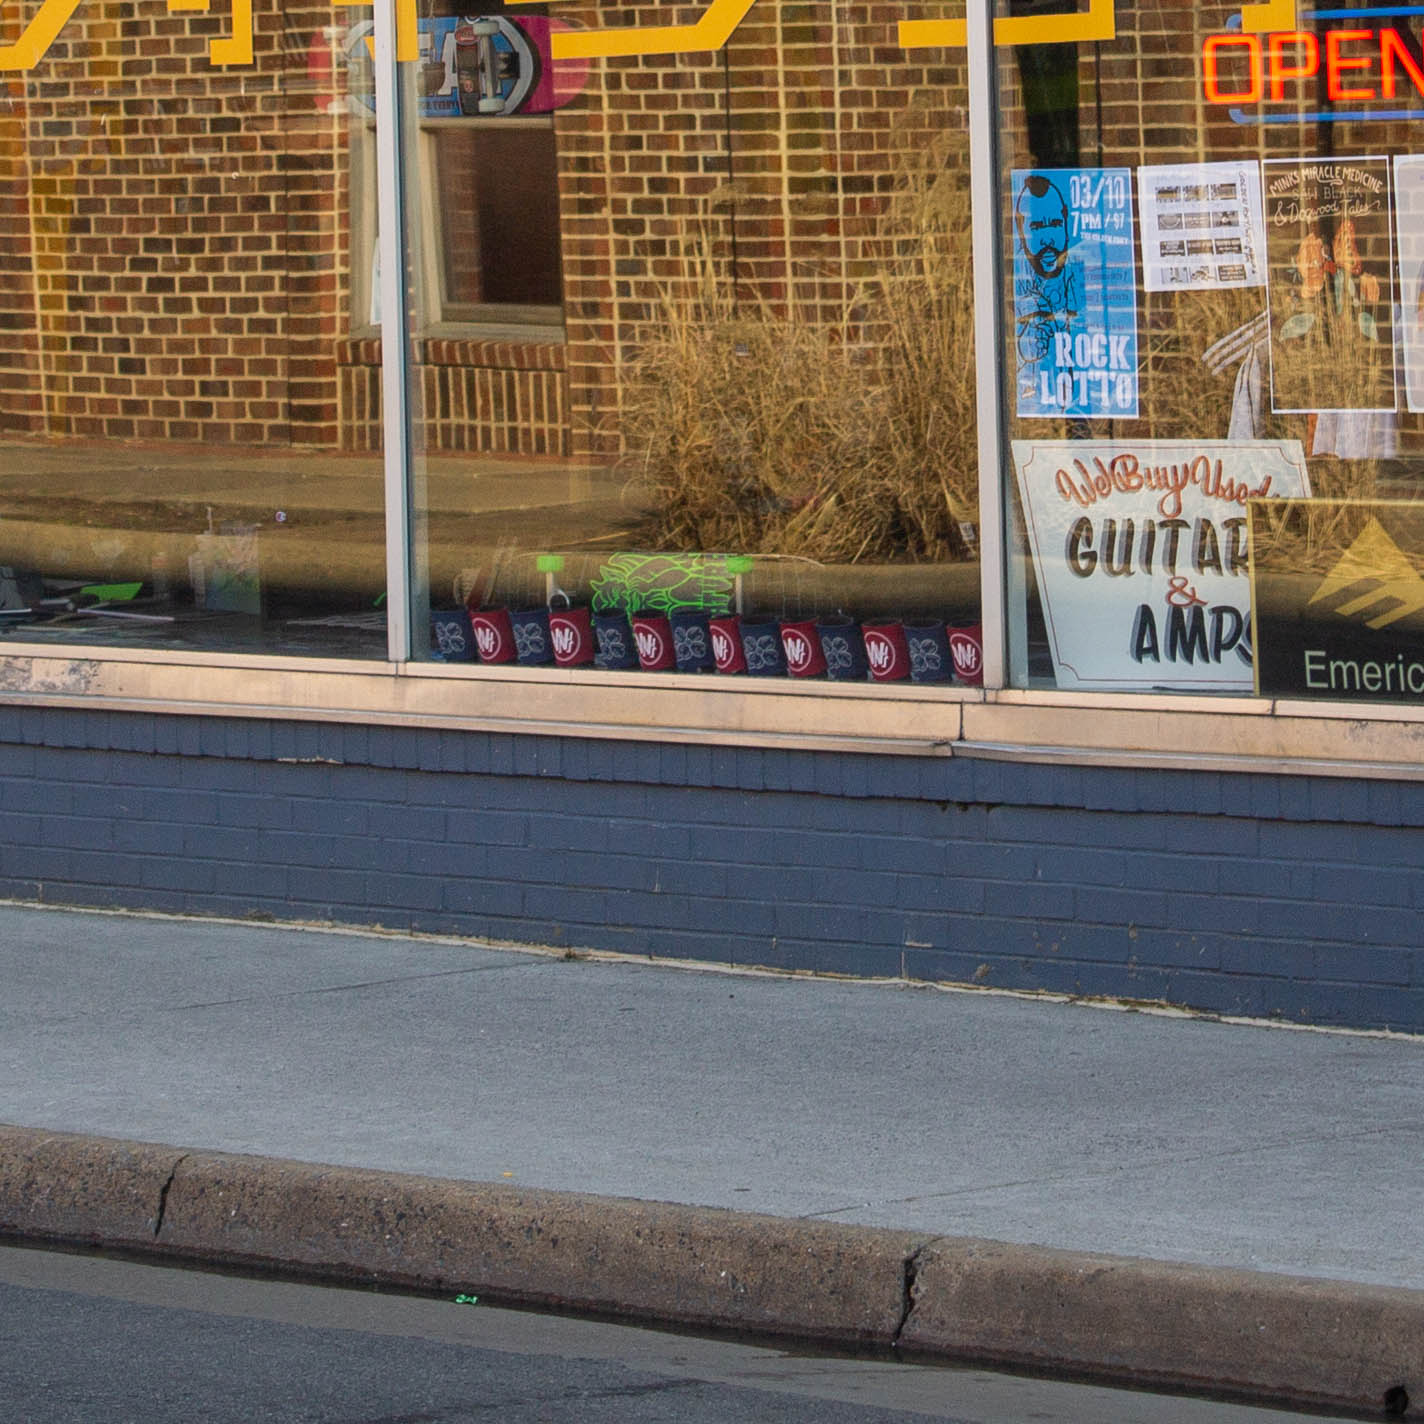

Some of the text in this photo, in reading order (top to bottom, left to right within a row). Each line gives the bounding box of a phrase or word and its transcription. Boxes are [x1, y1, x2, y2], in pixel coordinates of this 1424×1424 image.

[1070, 175, 1125, 209] 03/10
[1301, 166, 1343, 185] MIRACLE
[1342, 166, 1383, 193] MEDICINE
[1274, 200, 1288, 226] &
[1286, 200, 1340, 224] Dogwood
[1055, 332, 1131, 371] ROCK
[1040, 370, 1133, 409] LOTTO
[1056, 454, 1276, 518] We Buy Used
[1165, 576, 1208, 607] &
